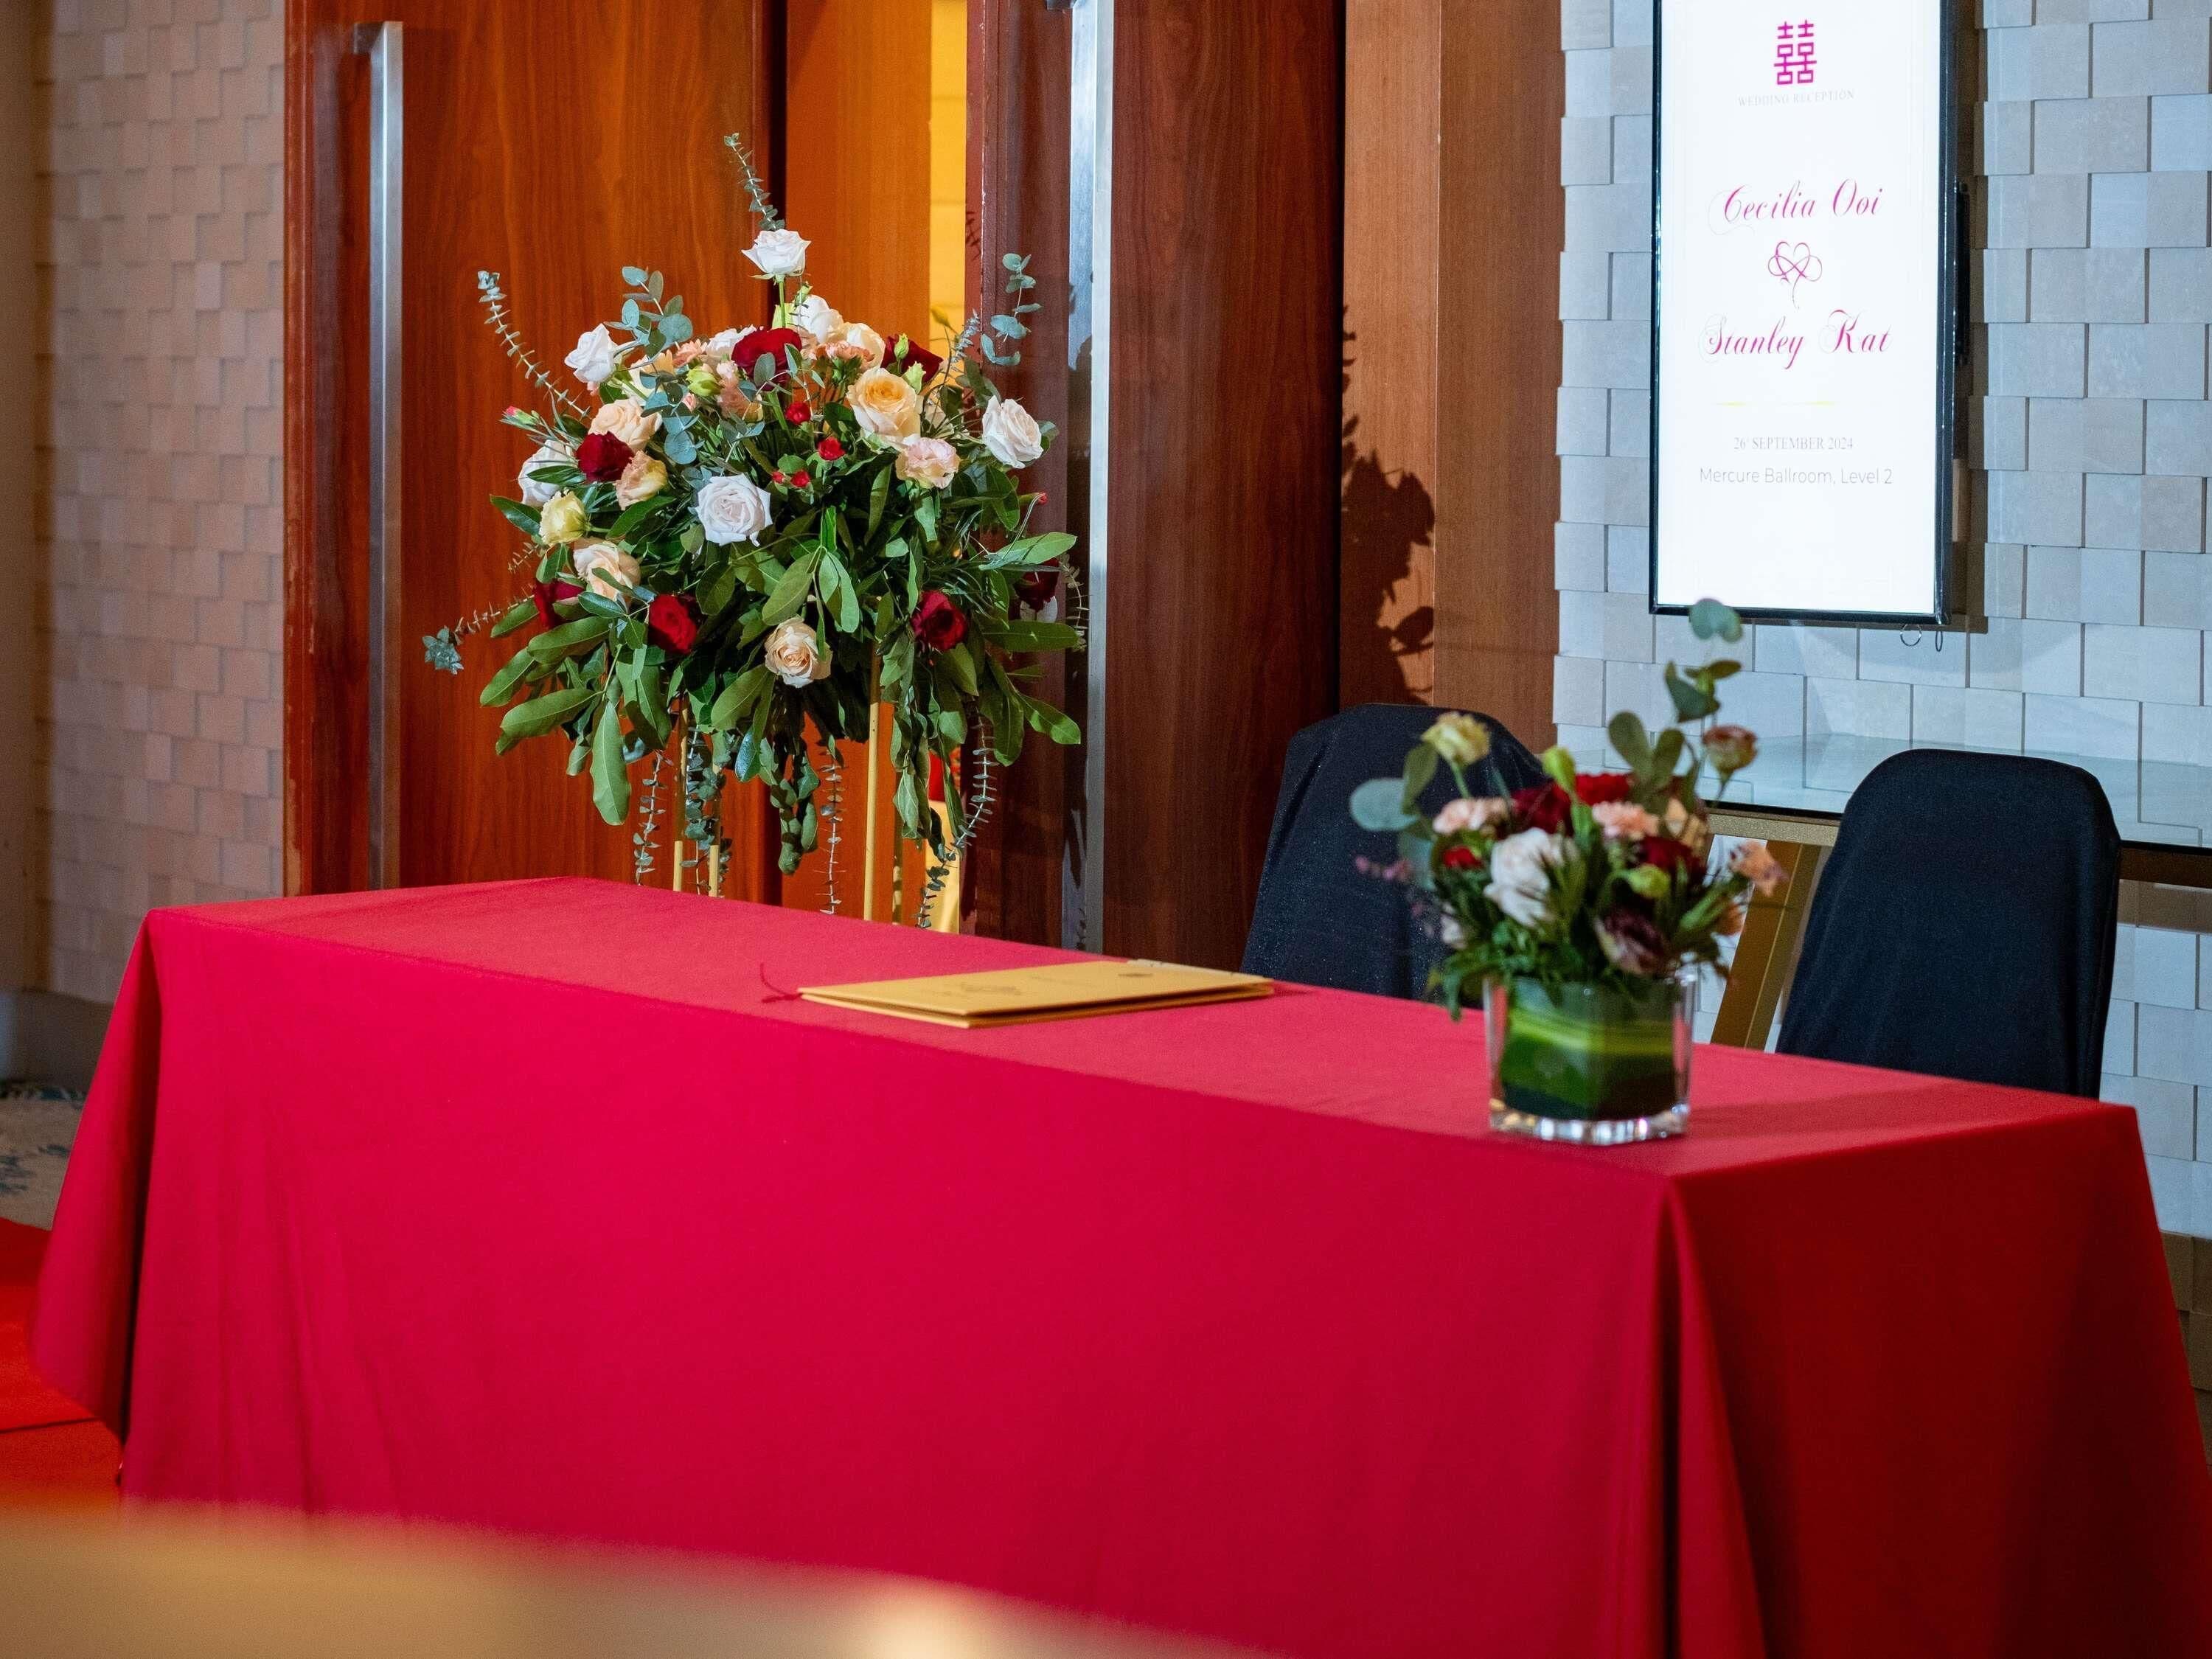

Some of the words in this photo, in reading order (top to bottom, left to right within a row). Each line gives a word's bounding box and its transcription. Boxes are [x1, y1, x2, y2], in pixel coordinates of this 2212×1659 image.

[1736, 94, 1790, 107] WEDDING
[1793, 88, 1855, 104] RECEPTION
[1708, 180, 1816, 235] Cecilia
[1832, 178, 1883, 218] Ooi
[1699, 313, 1805, 370] Stanley
[1751, 437, 1824, 450] SEPTEMBER
[1828, 437, 1854, 450] 2024
[1699, 467, 1760, 484] Mercure
[1764, 467, 1836, 485] Ballroom,
[1841, 467, 1879, 484] Level
[1883, 468, 1893, 484] 2
